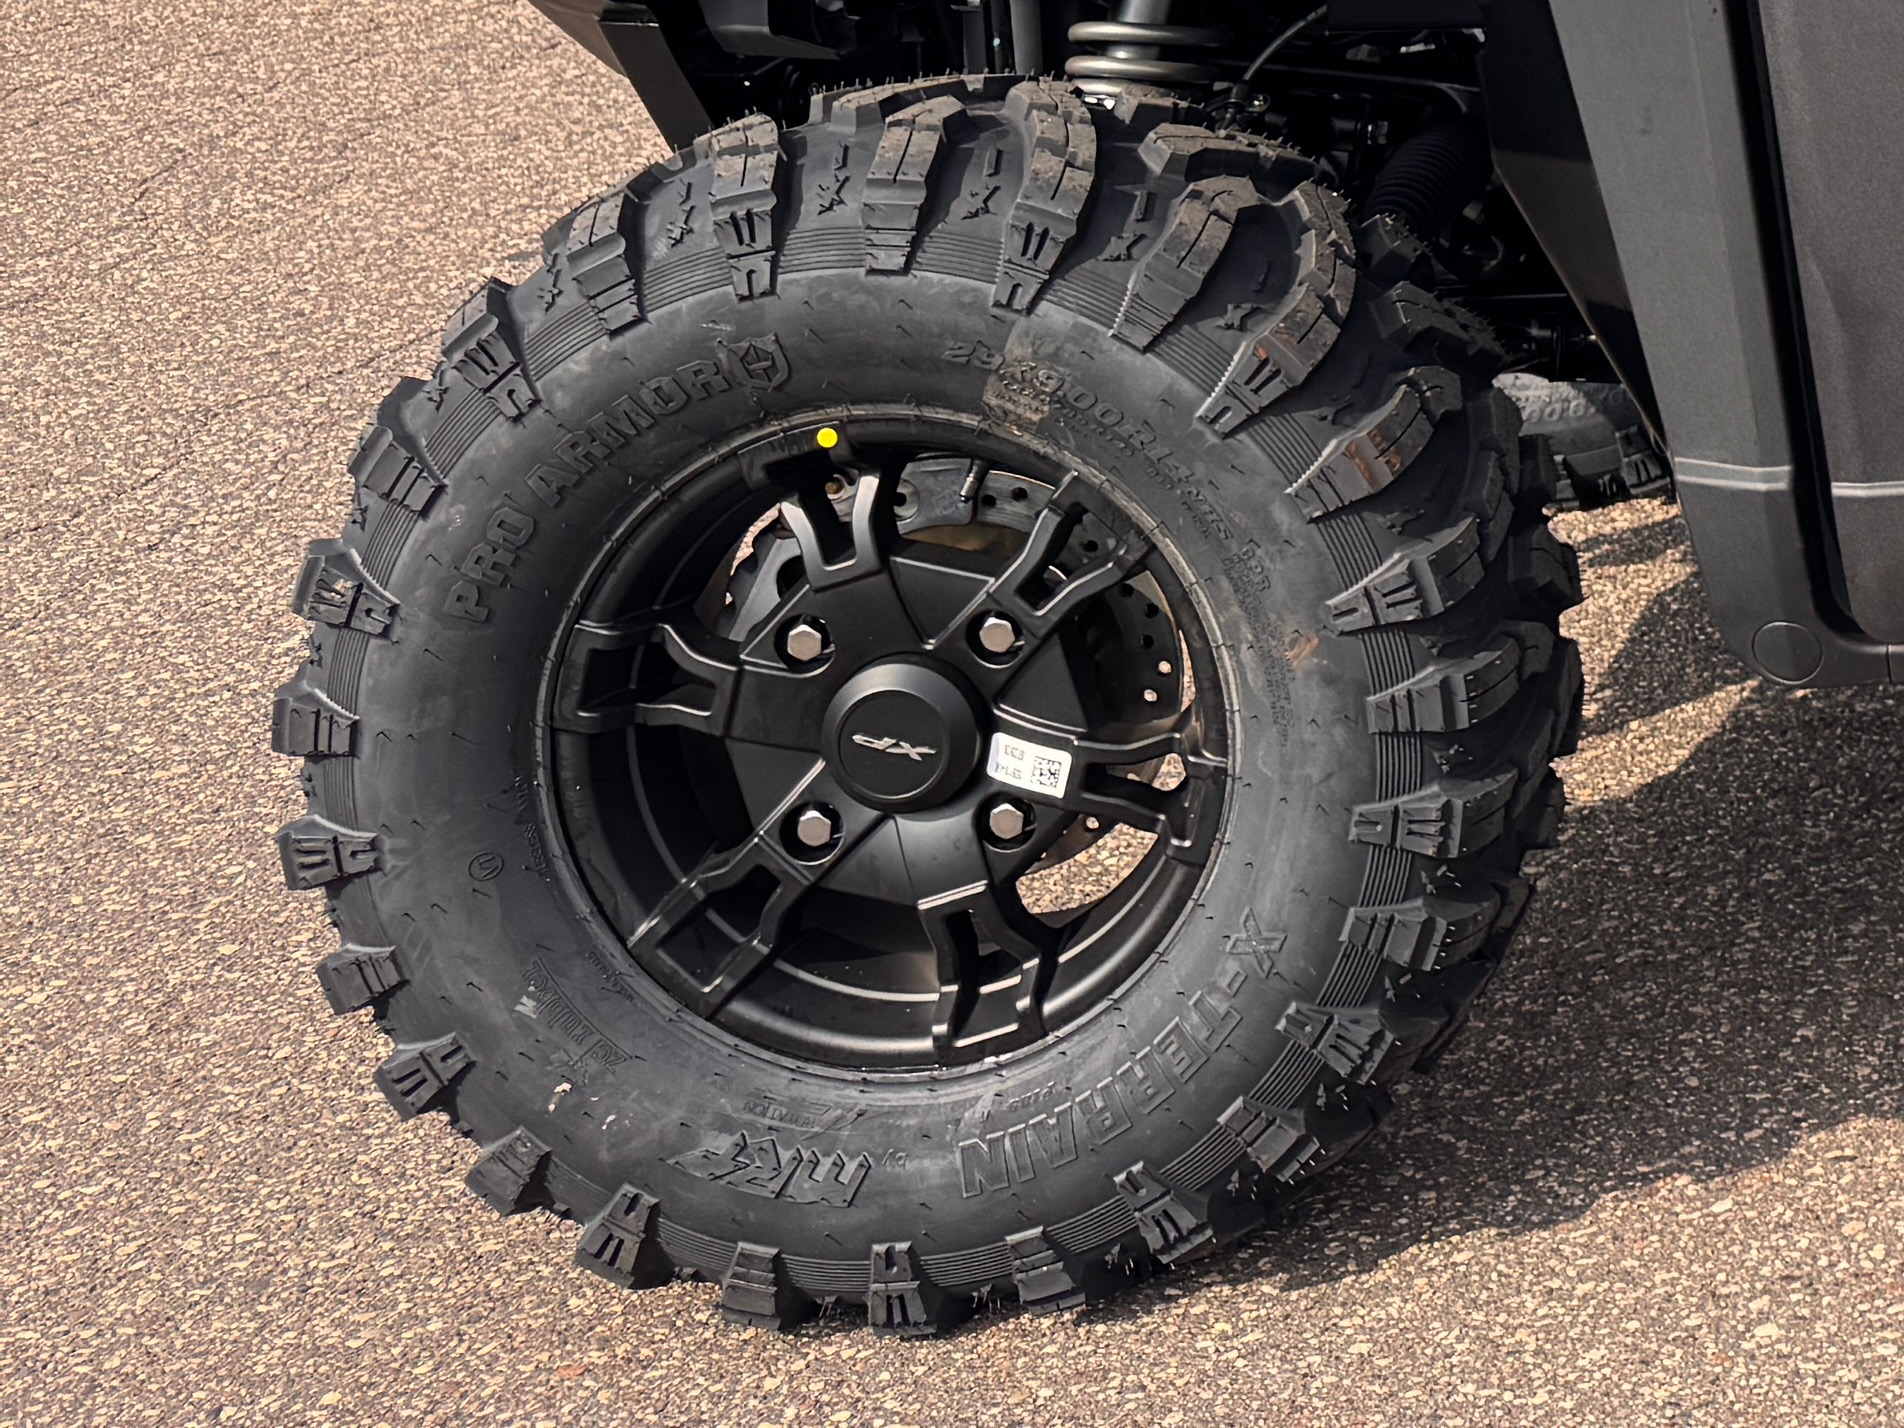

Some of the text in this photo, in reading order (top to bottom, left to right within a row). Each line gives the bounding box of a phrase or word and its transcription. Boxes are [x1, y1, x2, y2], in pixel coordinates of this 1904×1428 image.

[443, 359, 732, 623] PRO ARMOR
[959, 907, 1288, 1198] X-TERRAIN
